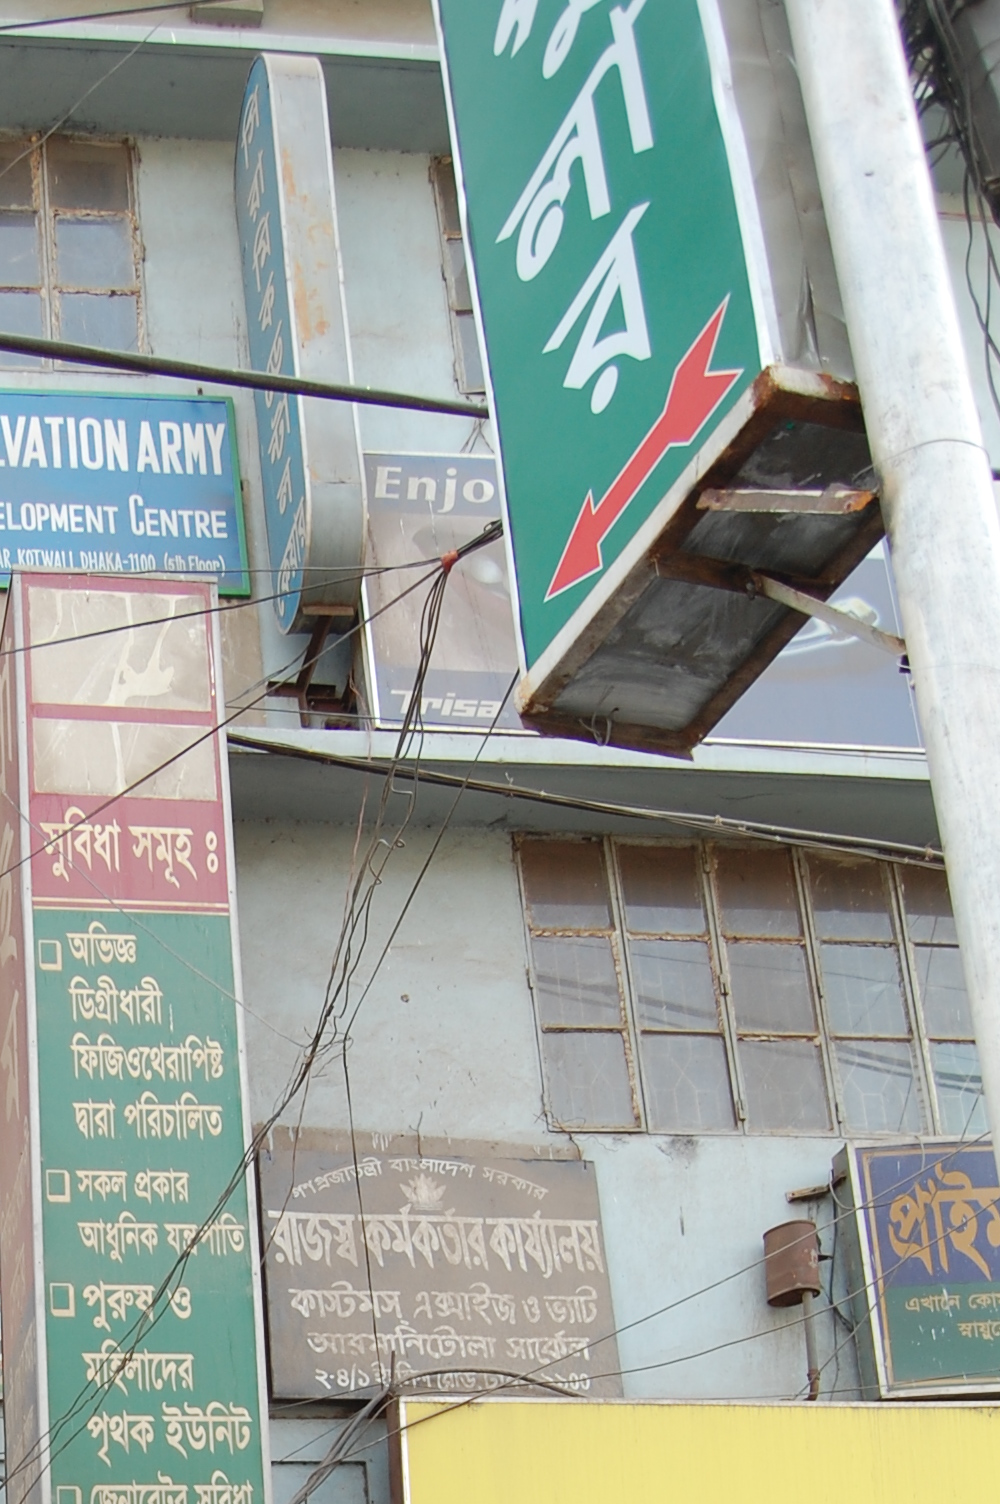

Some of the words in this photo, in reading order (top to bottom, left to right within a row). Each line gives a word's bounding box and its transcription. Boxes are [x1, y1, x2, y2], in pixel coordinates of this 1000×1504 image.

[137, 421, 225, 475] ARMY
[390, 689, 501, 717] Trisa
[40, 806, 121, 882] সুবিধা
[66, 921, 137, 965] অভিজ্ঞ
[124, 1091, 223, 1141] পরিচালিত
[76, 1170, 127, 1202] সকল
[134, 1169, 189, 1203] প্রকার
[390, 1159, 476, 1178] বাংলাদেশ
[482, 1167, 549, 1201] সরকার
[78, 1211, 157, 1263] আধুনিক
[268, 1210, 357, 1268] রাজস্ব
[82, 1284, 154, 1332] পুরুষ
[168, 1287, 192, 1320] ও
[414, 1282, 516, 1325] এক্সাইজ
[522, 1298, 540, 1324] ও
[905, 1293, 960, 1313] এখানে
[82, 1339, 195, 1397] মহিলাদের
[87, 1414, 154, 1467] পৃথক
[163, 1402, 253, 1459] ইউনিট
